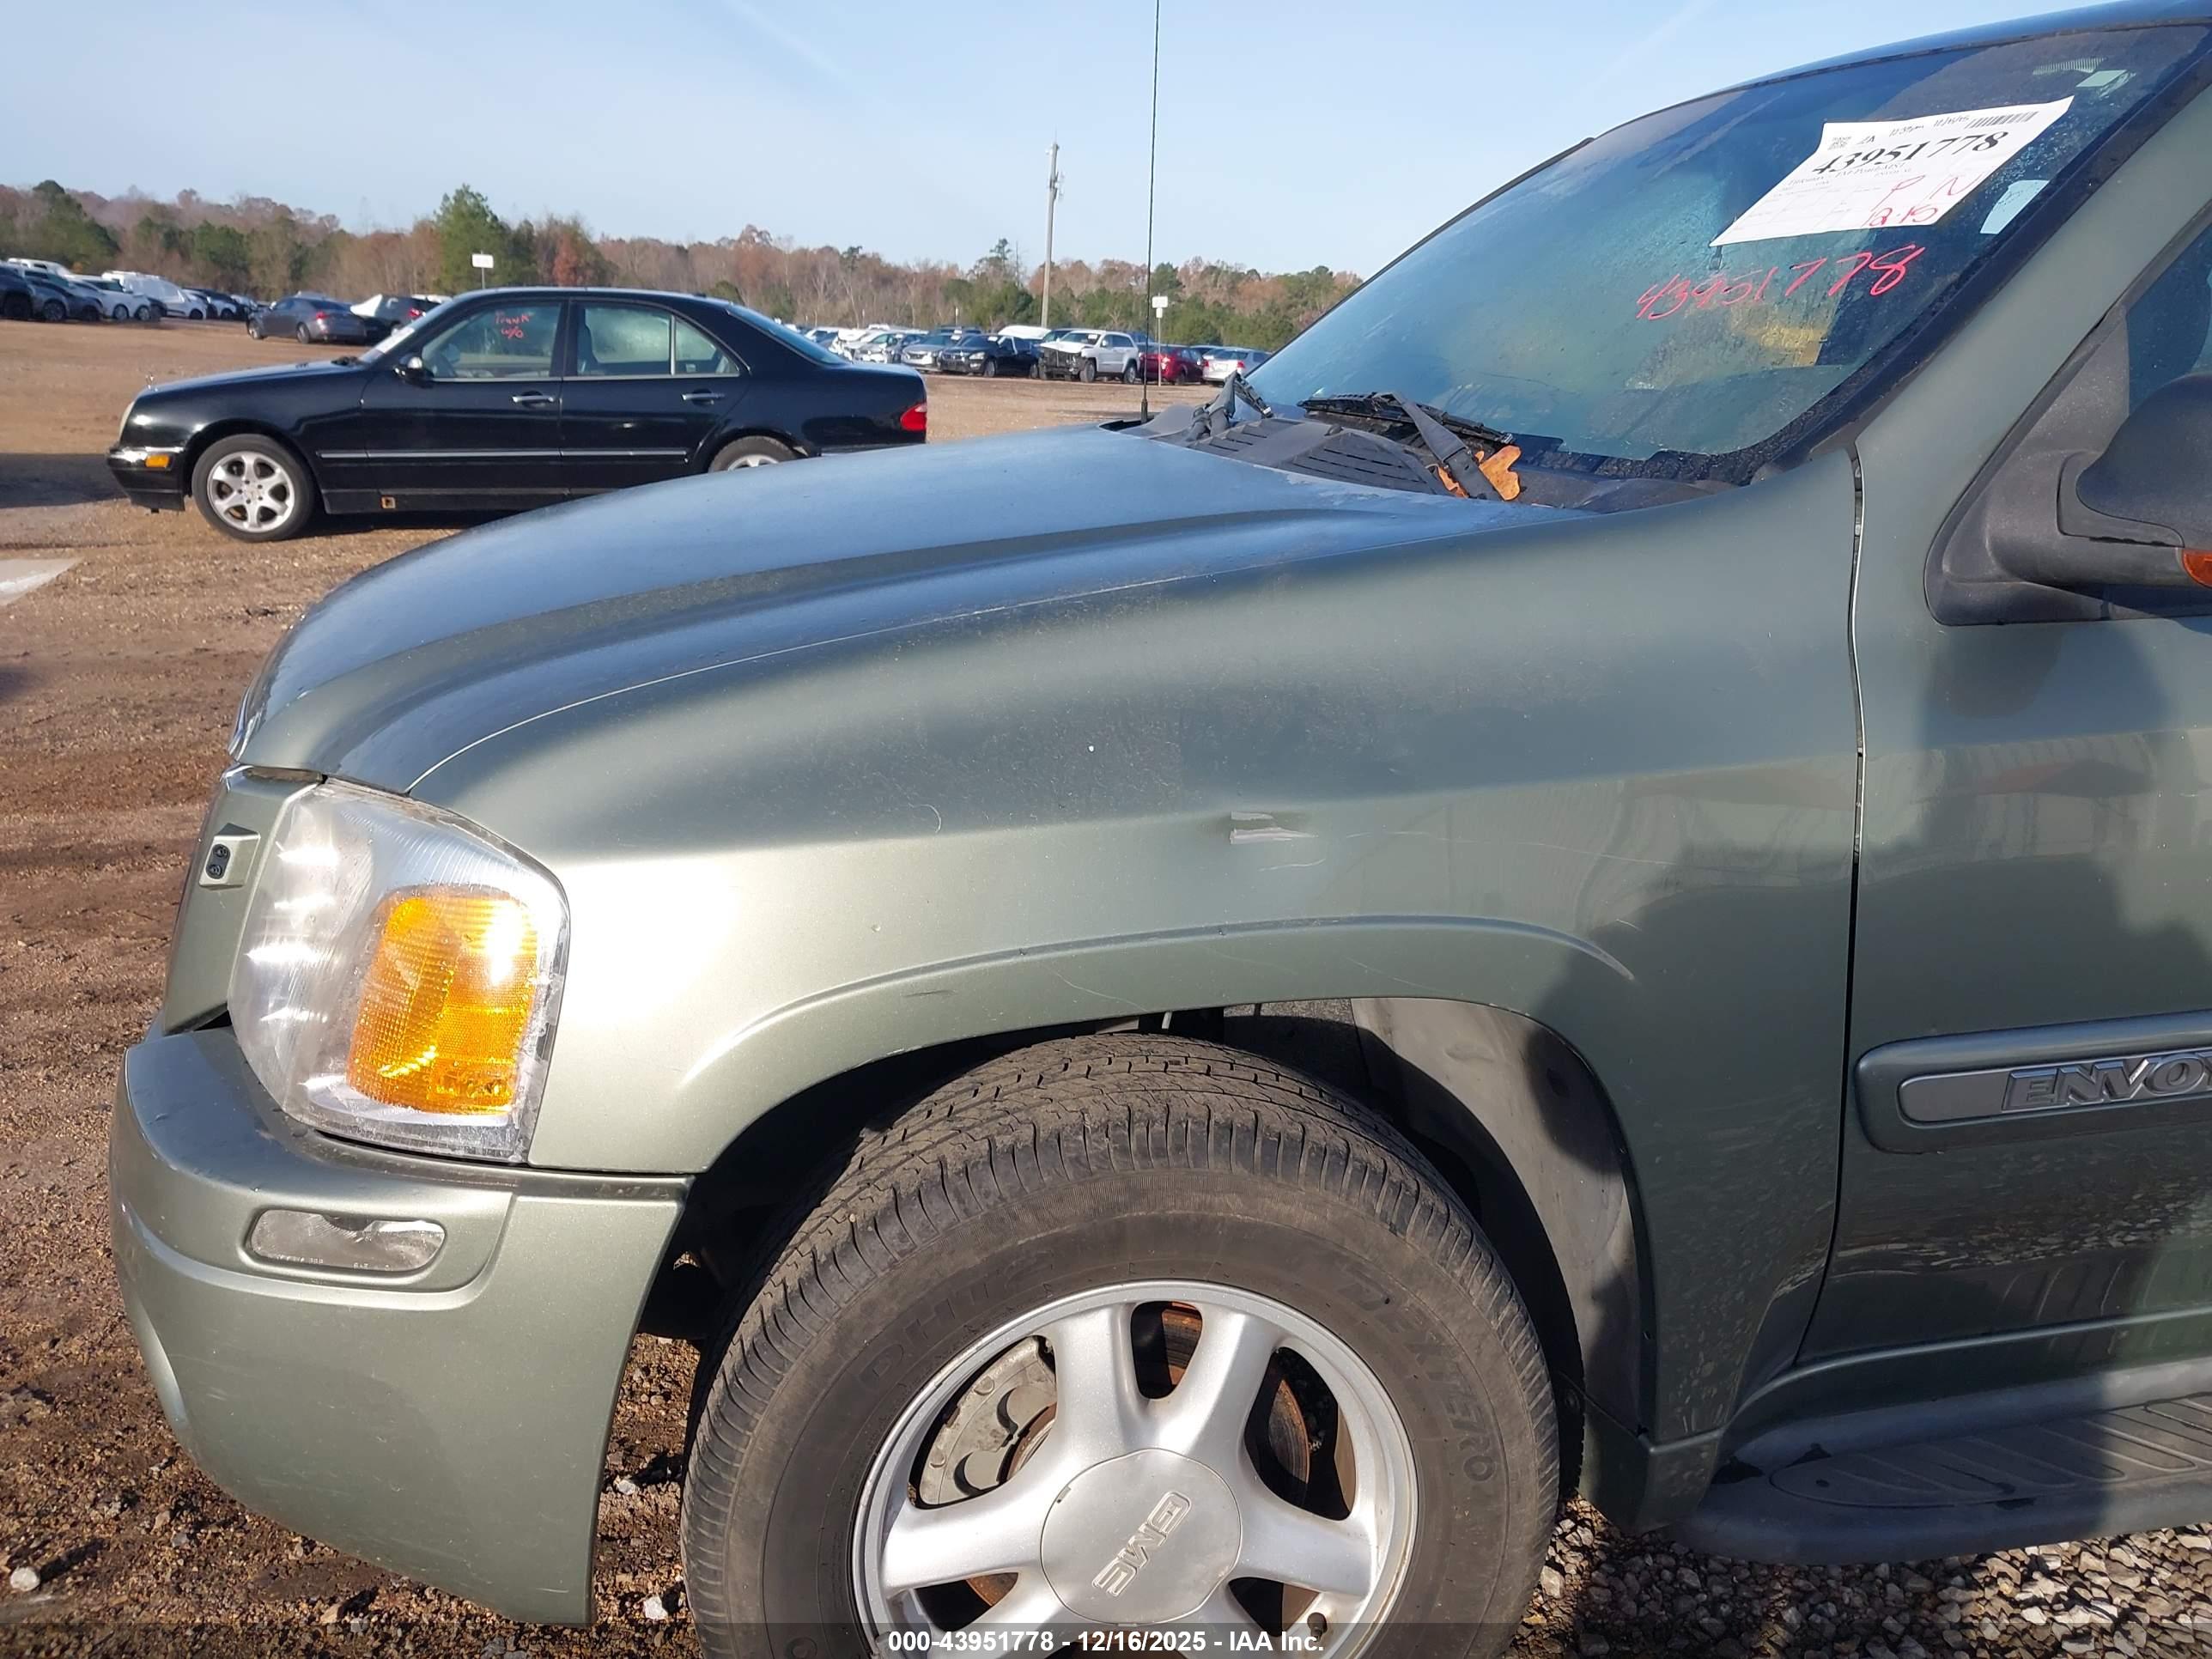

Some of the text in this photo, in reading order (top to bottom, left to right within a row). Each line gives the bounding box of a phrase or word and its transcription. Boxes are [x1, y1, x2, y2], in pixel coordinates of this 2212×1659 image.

[1812, 131, 2008, 175] 43951778
[1636, 244, 1926, 321] 43951778
[1091, 1490, 1192, 1597] GMC
